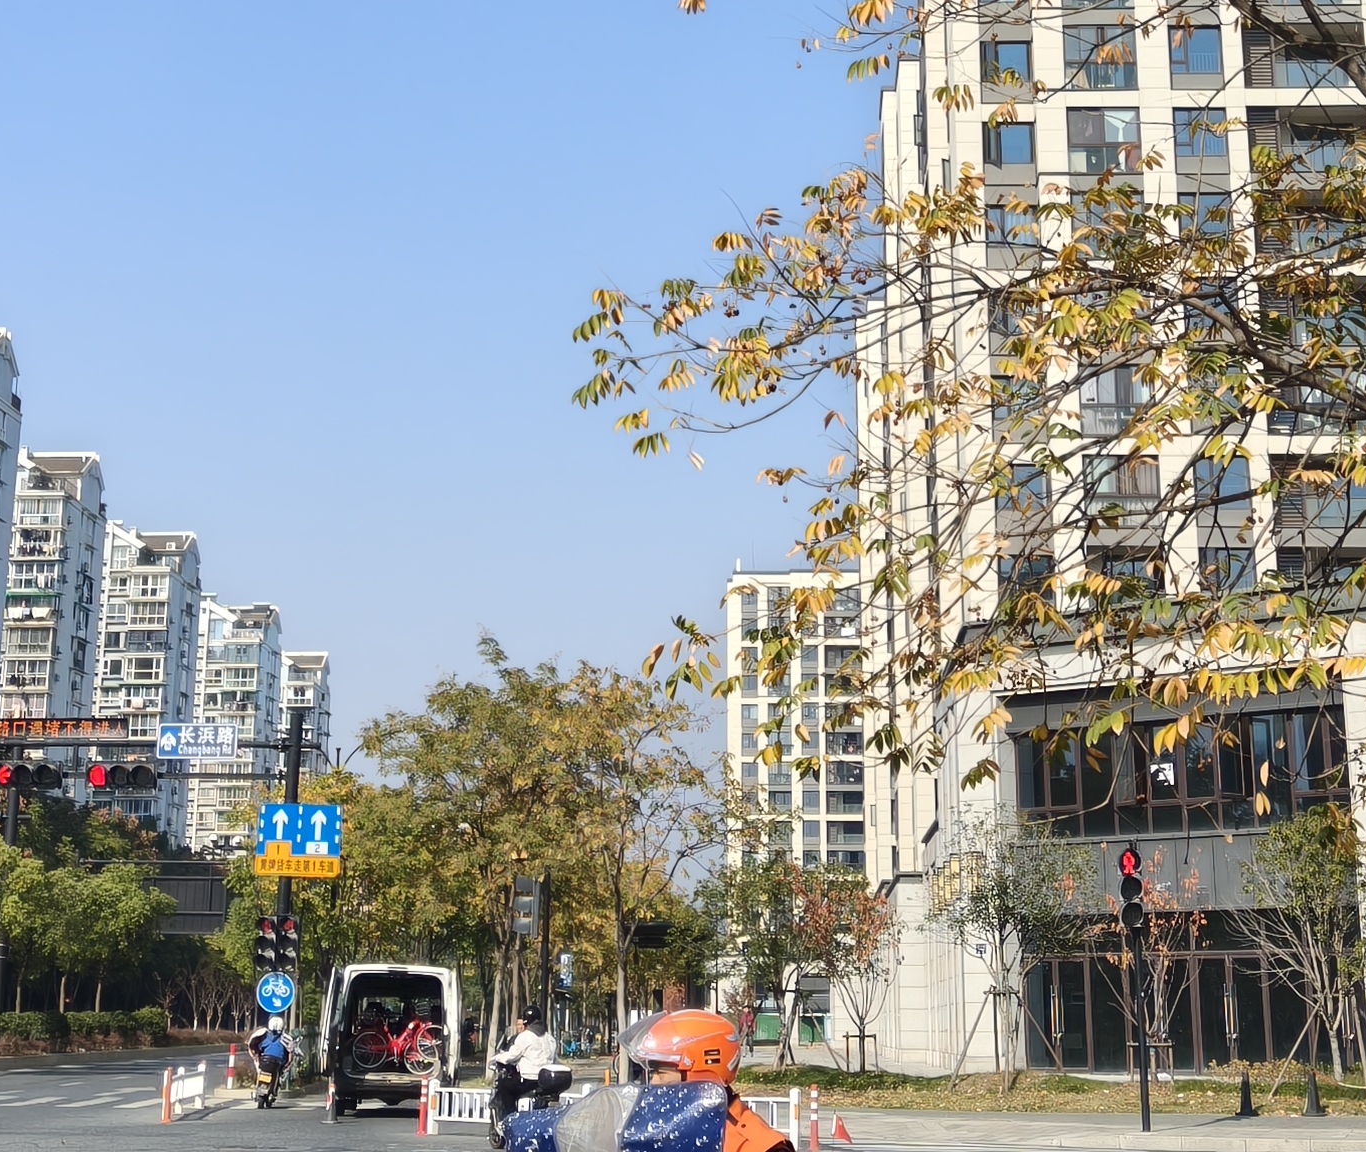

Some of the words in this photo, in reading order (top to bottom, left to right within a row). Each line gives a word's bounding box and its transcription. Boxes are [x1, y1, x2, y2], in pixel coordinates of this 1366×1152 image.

[178, 726, 234, 744] 长浜路
[178, 744, 221, 757] Changbang
[222, 744, 232, 755] Rd
[314, 843, 321, 853] 2
